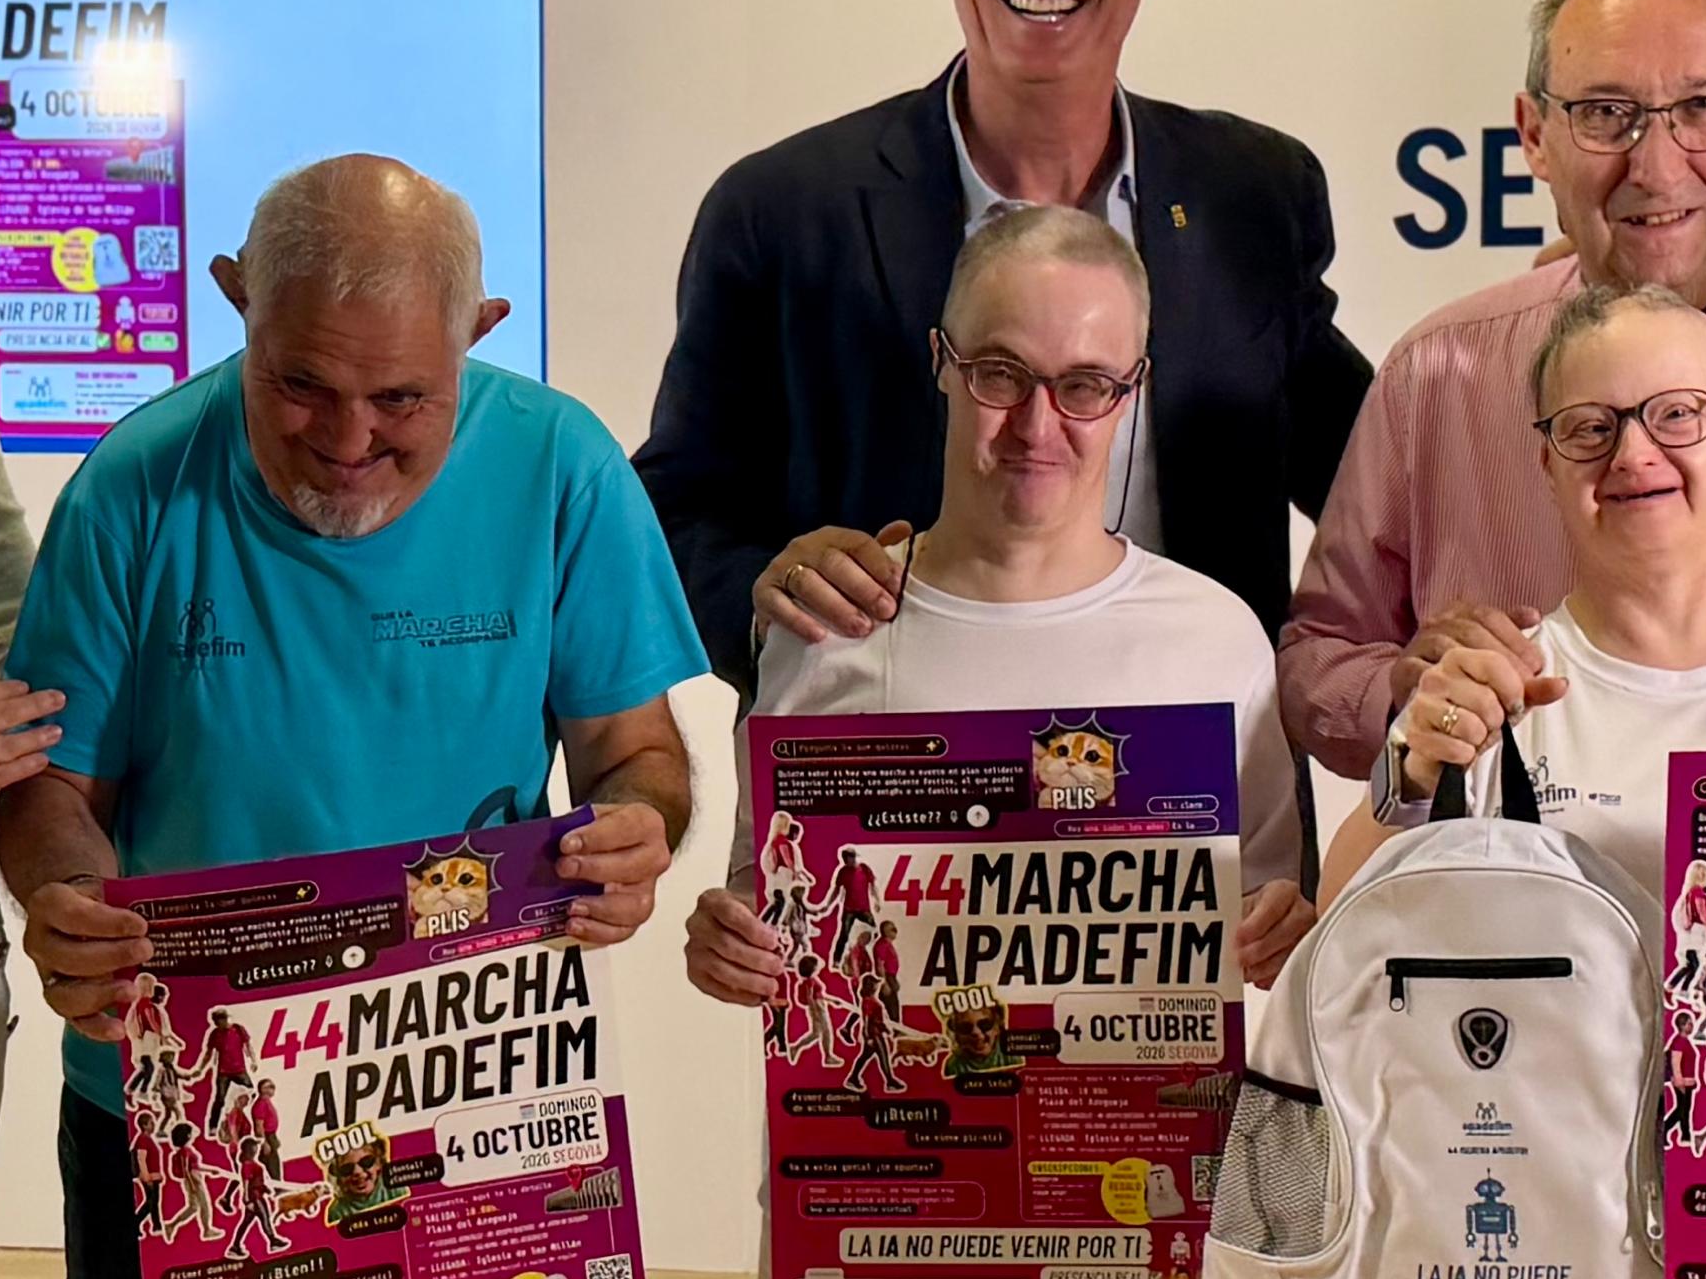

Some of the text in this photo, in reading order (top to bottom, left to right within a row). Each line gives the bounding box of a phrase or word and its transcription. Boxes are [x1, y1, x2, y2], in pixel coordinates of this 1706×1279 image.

[30, 301, 67, 321] POR
[73, 301, 90, 320] TI
[919, 920, 1224, 988] APADEFIM
[1063, 1014, 1217, 1043] 4 OCTUBRE
[299, 1015, 597, 1139] APADEFIM
[446, 1109, 601, 1162] 4 OCTUBRE
